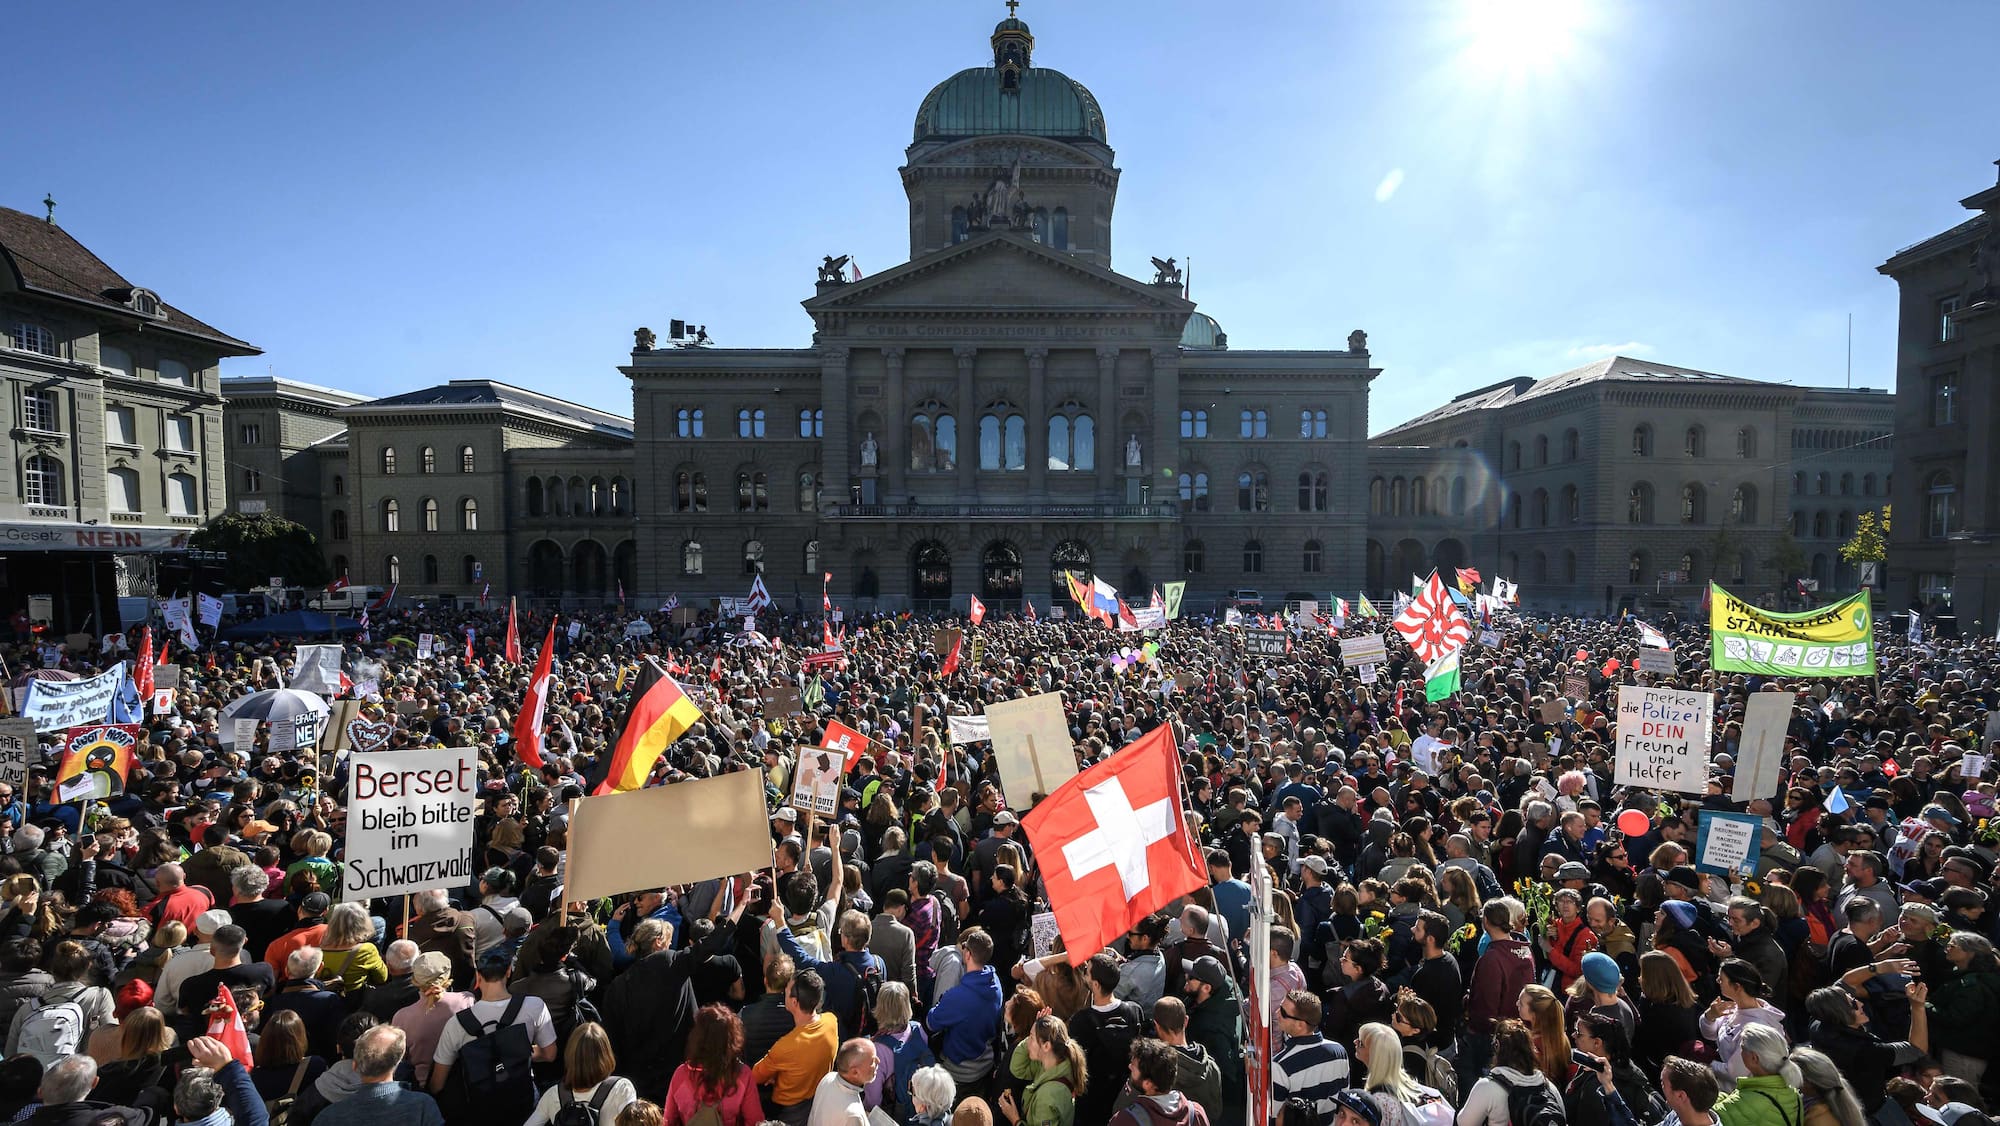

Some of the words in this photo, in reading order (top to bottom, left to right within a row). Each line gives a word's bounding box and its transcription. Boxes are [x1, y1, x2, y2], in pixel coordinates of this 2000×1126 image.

[76, 530, 142, 548] NEIN
[1260, 640, 1284, 654] Volk
[40, 700, 67, 712] mehr
[1645, 691, 1697, 706] merke
[80, 705, 107, 720] Mens
[1621, 701, 1640, 714] die
[1642, 701, 1702, 723] Polizei
[357, 729, 381, 742] nein
[1641, 722, 1685, 739] DEIN
[1624, 734, 1689, 756] Freund
[1649, 755, 1674, 765] und
[355, 758, 471, 800] Berset
[1629, 761, 1683, 783] Helfer
[362, 805, 417, 831] bleib
[422, 801, 471, 825] bitte
[391, 830, 418, 850] im
[348, 847, 472, 891] Schwarzwald
